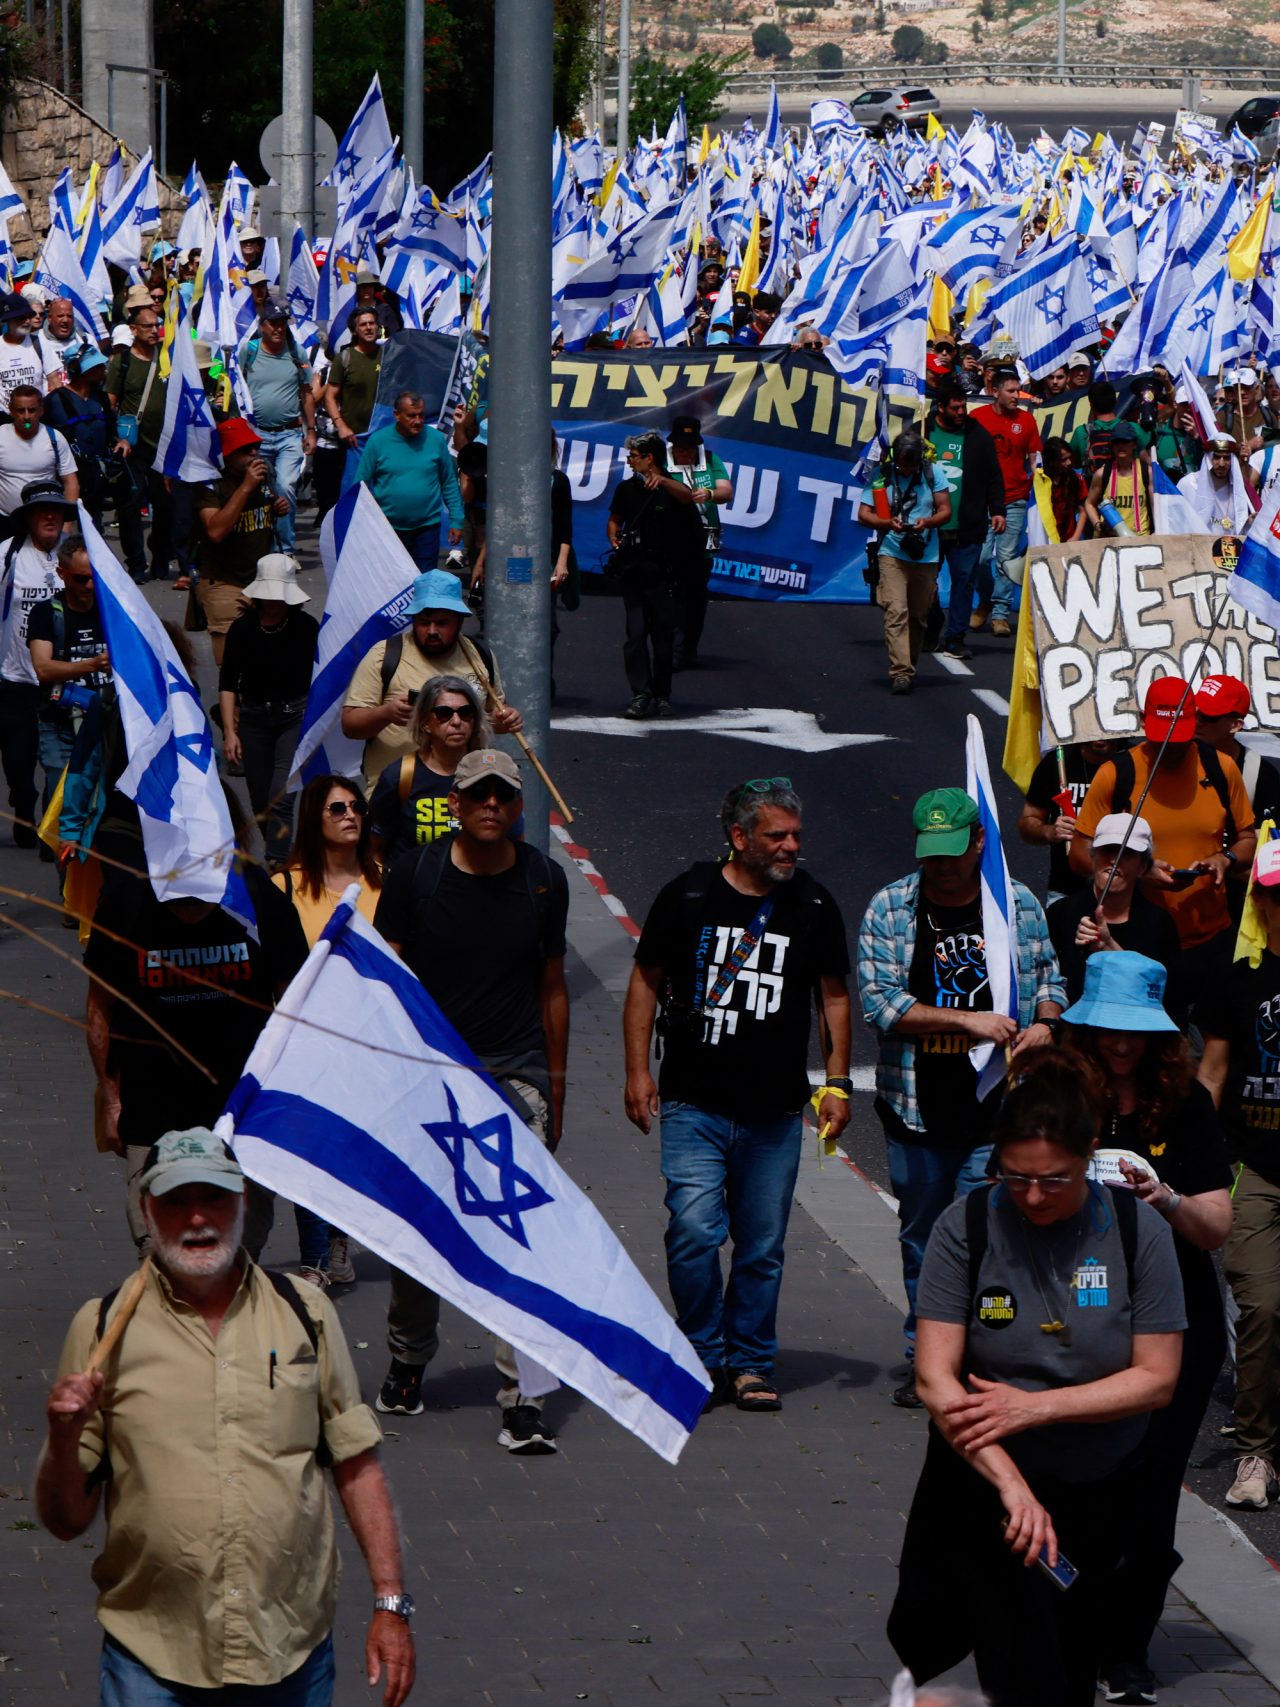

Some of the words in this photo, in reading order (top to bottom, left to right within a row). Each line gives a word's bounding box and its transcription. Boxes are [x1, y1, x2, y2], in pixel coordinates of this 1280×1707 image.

[760, 566, 807, 589] חופשי
[22, 588, 48, 599] כיפור
[1030, 545, 1173, 651] WE
[147, 942, 250, 968] מושחתים
[1077, 1272, 1108, 1289] בונים
[1077, 1289, 1108, 1306] מחדש
[980, 1308, 1014, 1320] החטופים
